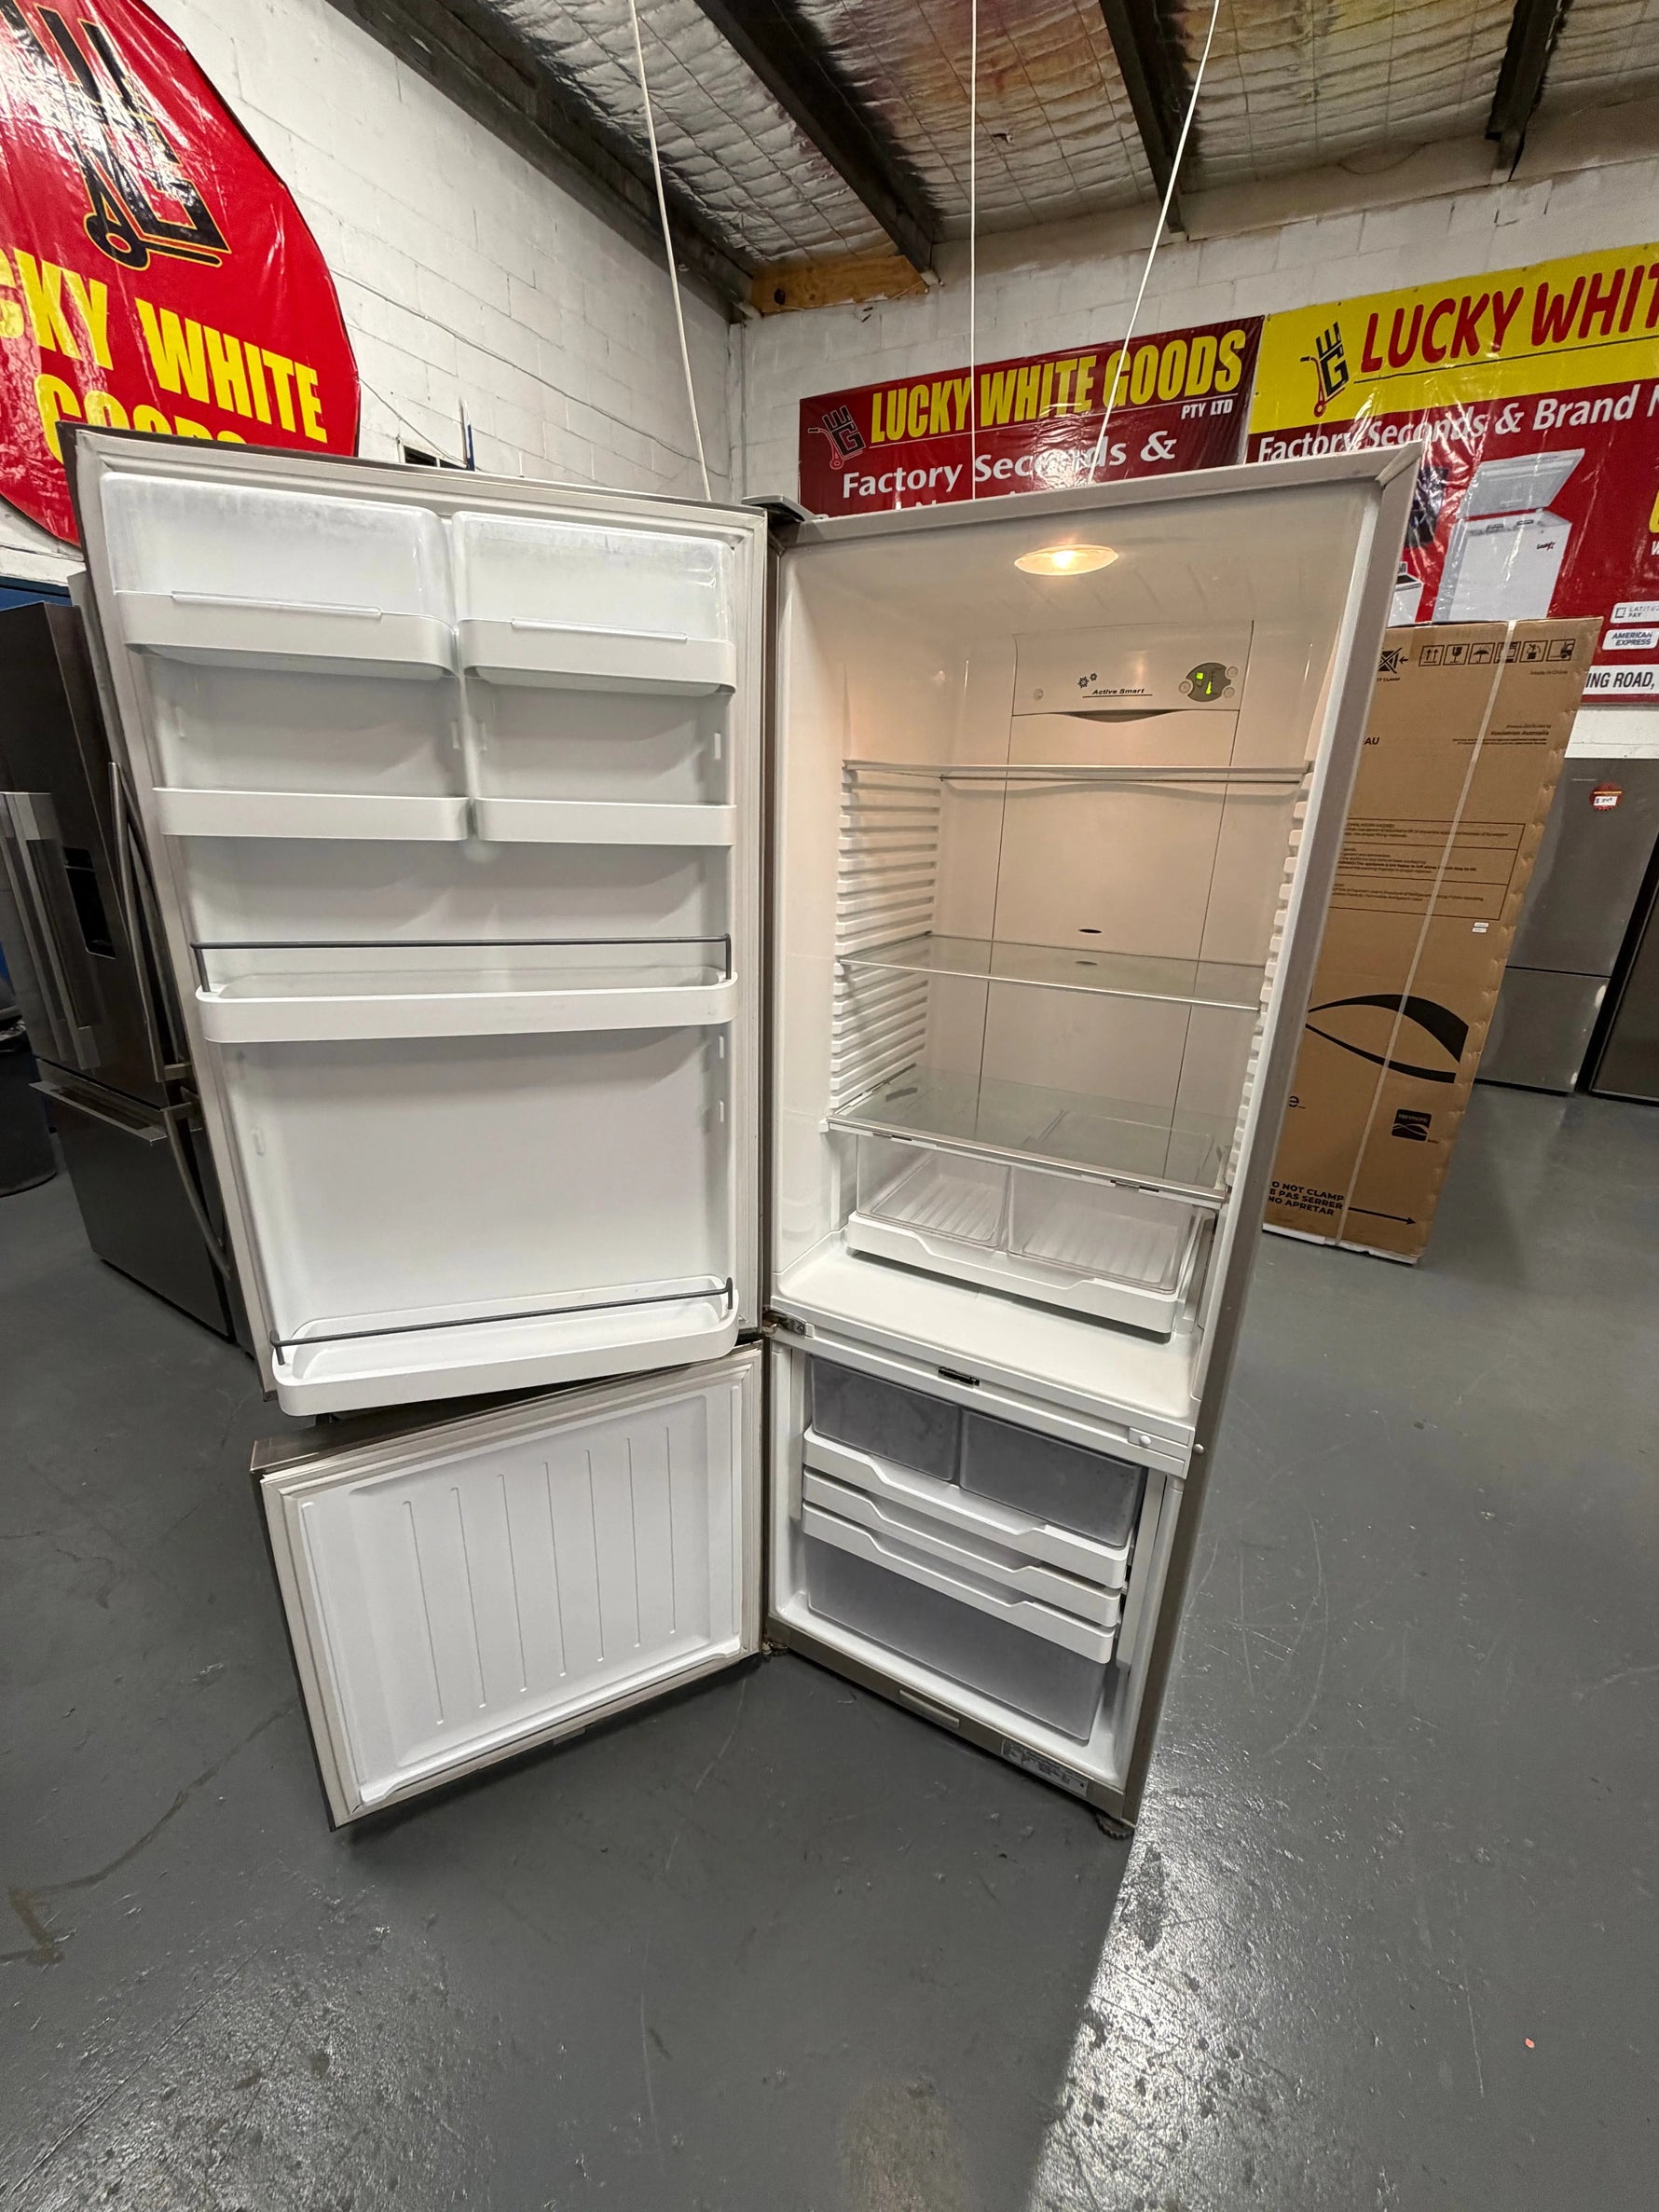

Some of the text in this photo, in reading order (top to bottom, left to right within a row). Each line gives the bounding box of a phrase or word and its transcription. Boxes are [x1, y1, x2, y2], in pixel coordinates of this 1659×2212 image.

[1360, 287, 1524, 373] LUCKY
[135, 297, 328, 444] WHITE
[871, 329, 1246, 443] LUCKY WHITE GOODS
[1181, 399, 1233, 419] PTY LTD
[1494, 402, 1525, 434] &
[1532, 383, 1640, 431] Brand
[843, 464, 963, 499] Factory
[1140, 431, 1177, 462] &
[1611, 631, 1652, 640] AMERICAN
[1615, 639, 1652, 647] EXPRESS
[1612, 671, 1655, 690] ROAD,
[1278, 1189, 1299, 1201] PAS
[1301, 1195, 1344, 1210] SERRER
[1282, 1183, 1305, 1194] NOT
[1306, 1188, 1344, 1202] CLAMP
[1284, 1199, 1335, 1216] APRETAR
